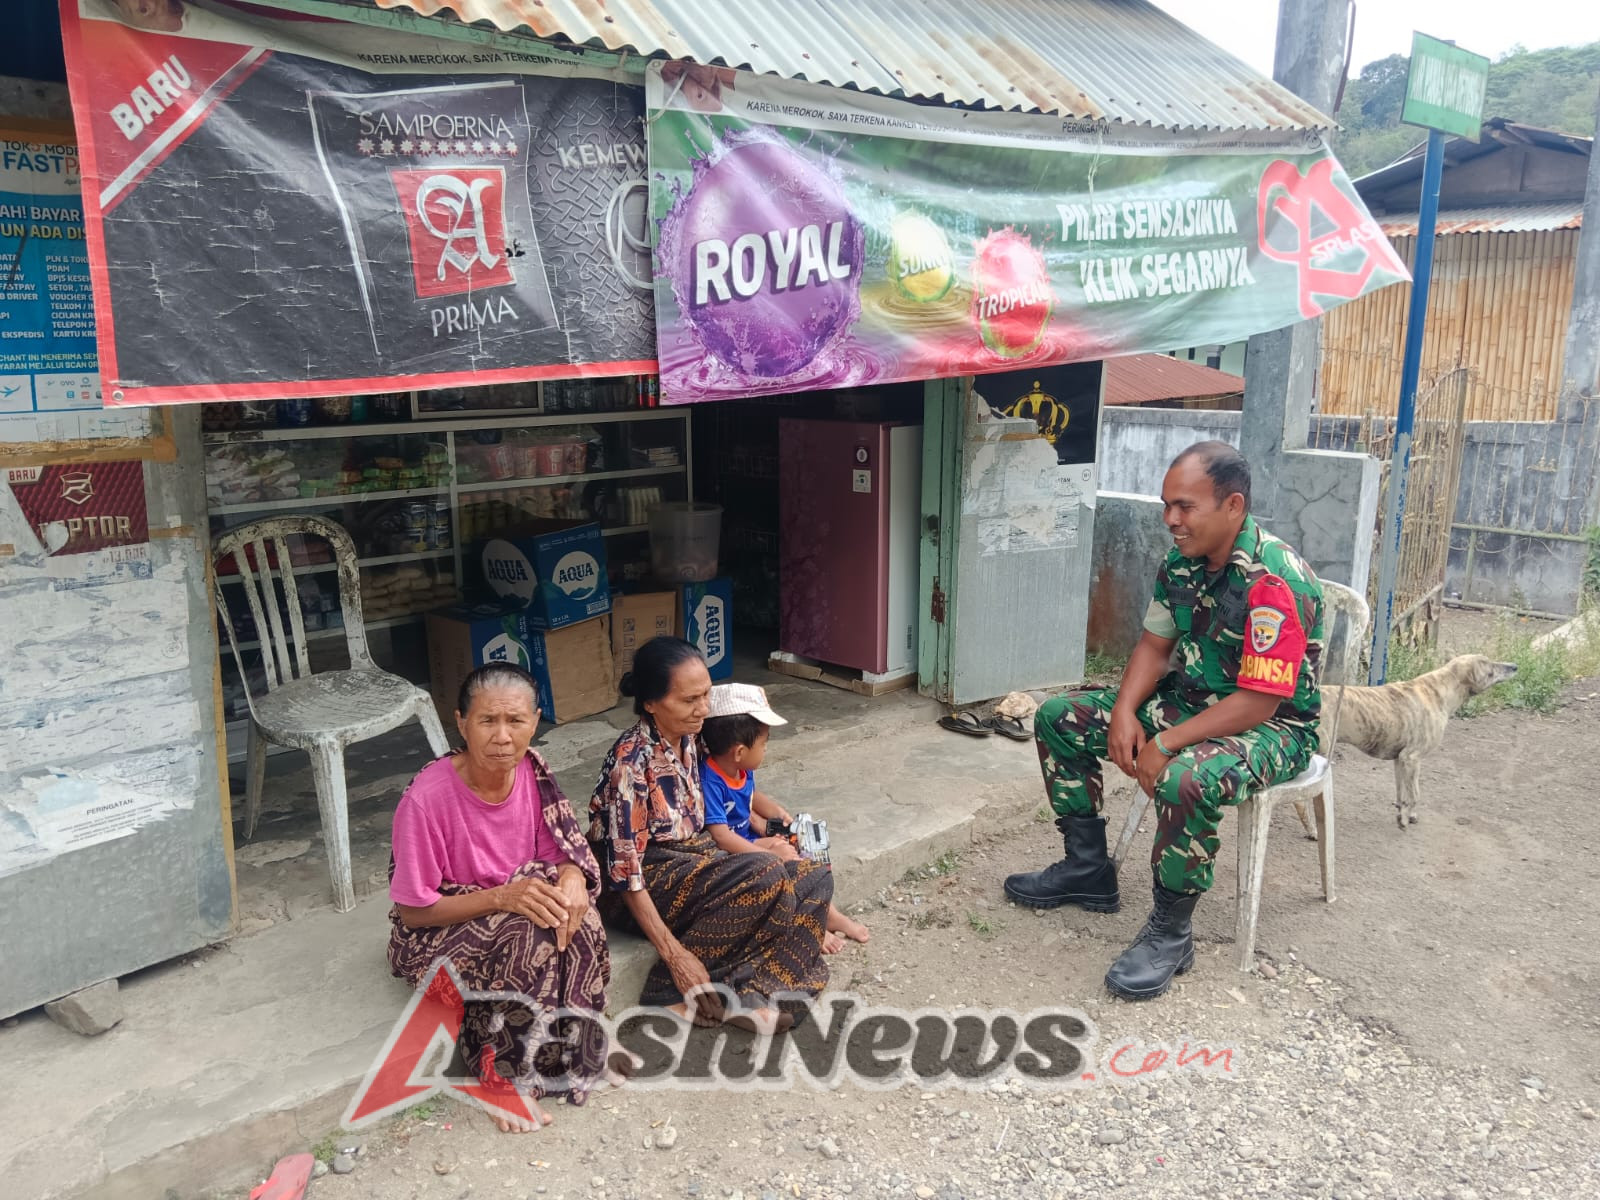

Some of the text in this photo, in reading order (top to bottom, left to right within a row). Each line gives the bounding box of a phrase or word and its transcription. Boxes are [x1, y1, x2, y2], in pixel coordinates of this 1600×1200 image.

[356, 53, 407, 64] KARENA
[473, 54, 503, 63] SAYA
[504, 52, 553, 64] TERKENA
[109, 54, 192, 141] BARU
[746, 100, 781, 113] KARENA
[827, 111, 848, 122] SAYA
[849, 113, 885, 126] TERKENA
[360, 111, 515, 140] SAMPOERNA
[30, 205, 80, 222] BAYAR
[1056, 198, 1238, 241] PILIH SENSASINYA
[30, 224, 63, 240] ADA
[46, 255, 61, 263] PLN
[693, 221, 852, 306] ROYAL
[47, 264, 70, 273] PDAM
[1080, 247, 1256, 303] KLIK SEGARNYA
[48, 284, 74, 292] SETOR
[7, 293, 39, 301] DRIVER
[49, 293, 87, 301] VOUCHER
[50, 302, 82, 310] TELKOM
[430, 295, 519, 337] PRIMA
[52, 321, 87, 329] TELEPON
[1, 331, 45, 339] EKSPEDISI
[53, 330, 80, 338] KARTU
[41, 352, 82, 361] MENERIMA
[29, 361, 64, 370] MELALUI
[65, 361, 86, 369] SCAN
[9, 469, 36, 481] BARU
[487, 558, 529, 584] AQUA
[558, 562, 594, 584] AQUA
[704, 605, 721, 658] AQUA
